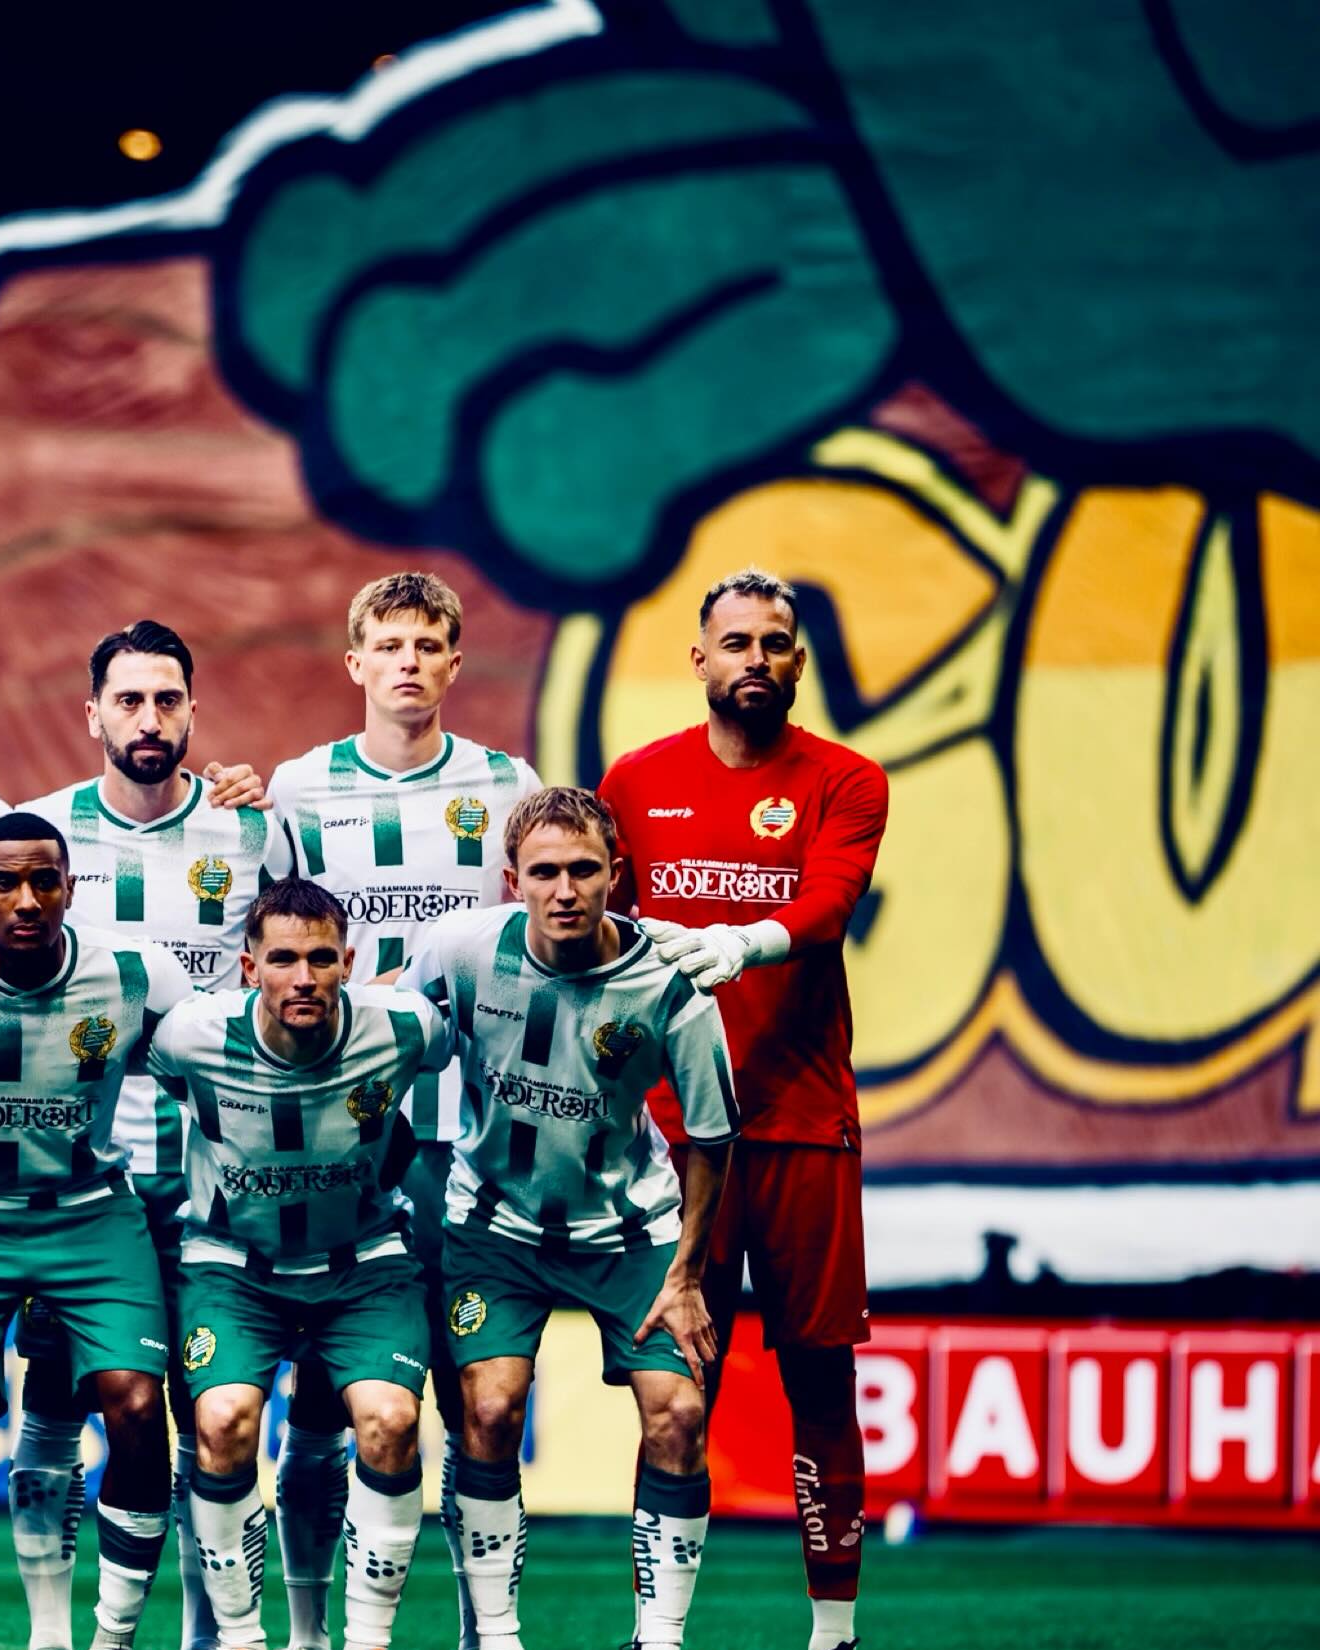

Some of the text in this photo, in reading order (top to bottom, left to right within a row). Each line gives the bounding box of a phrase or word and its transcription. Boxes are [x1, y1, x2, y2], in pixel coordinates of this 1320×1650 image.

[648, 808, 684, 818] CRAFT
[324, 818, 358, 829] CRAFT
[680, 859, 758, 872] TILLSAMMANS FÖR
[366, 884, 442, 894] TILLSAMMANS FÖR
[651, 863, 799, 902] SÖDERORT
[171, 940, 188, 949] FÖR
[477, 1003, 514, 1019] CRAFT
[219, 1099, 257, 1114] CRAFT
[856, 1354, 1320, 1484] BAUH
[792, 1453, 829, 1552] Clinton
